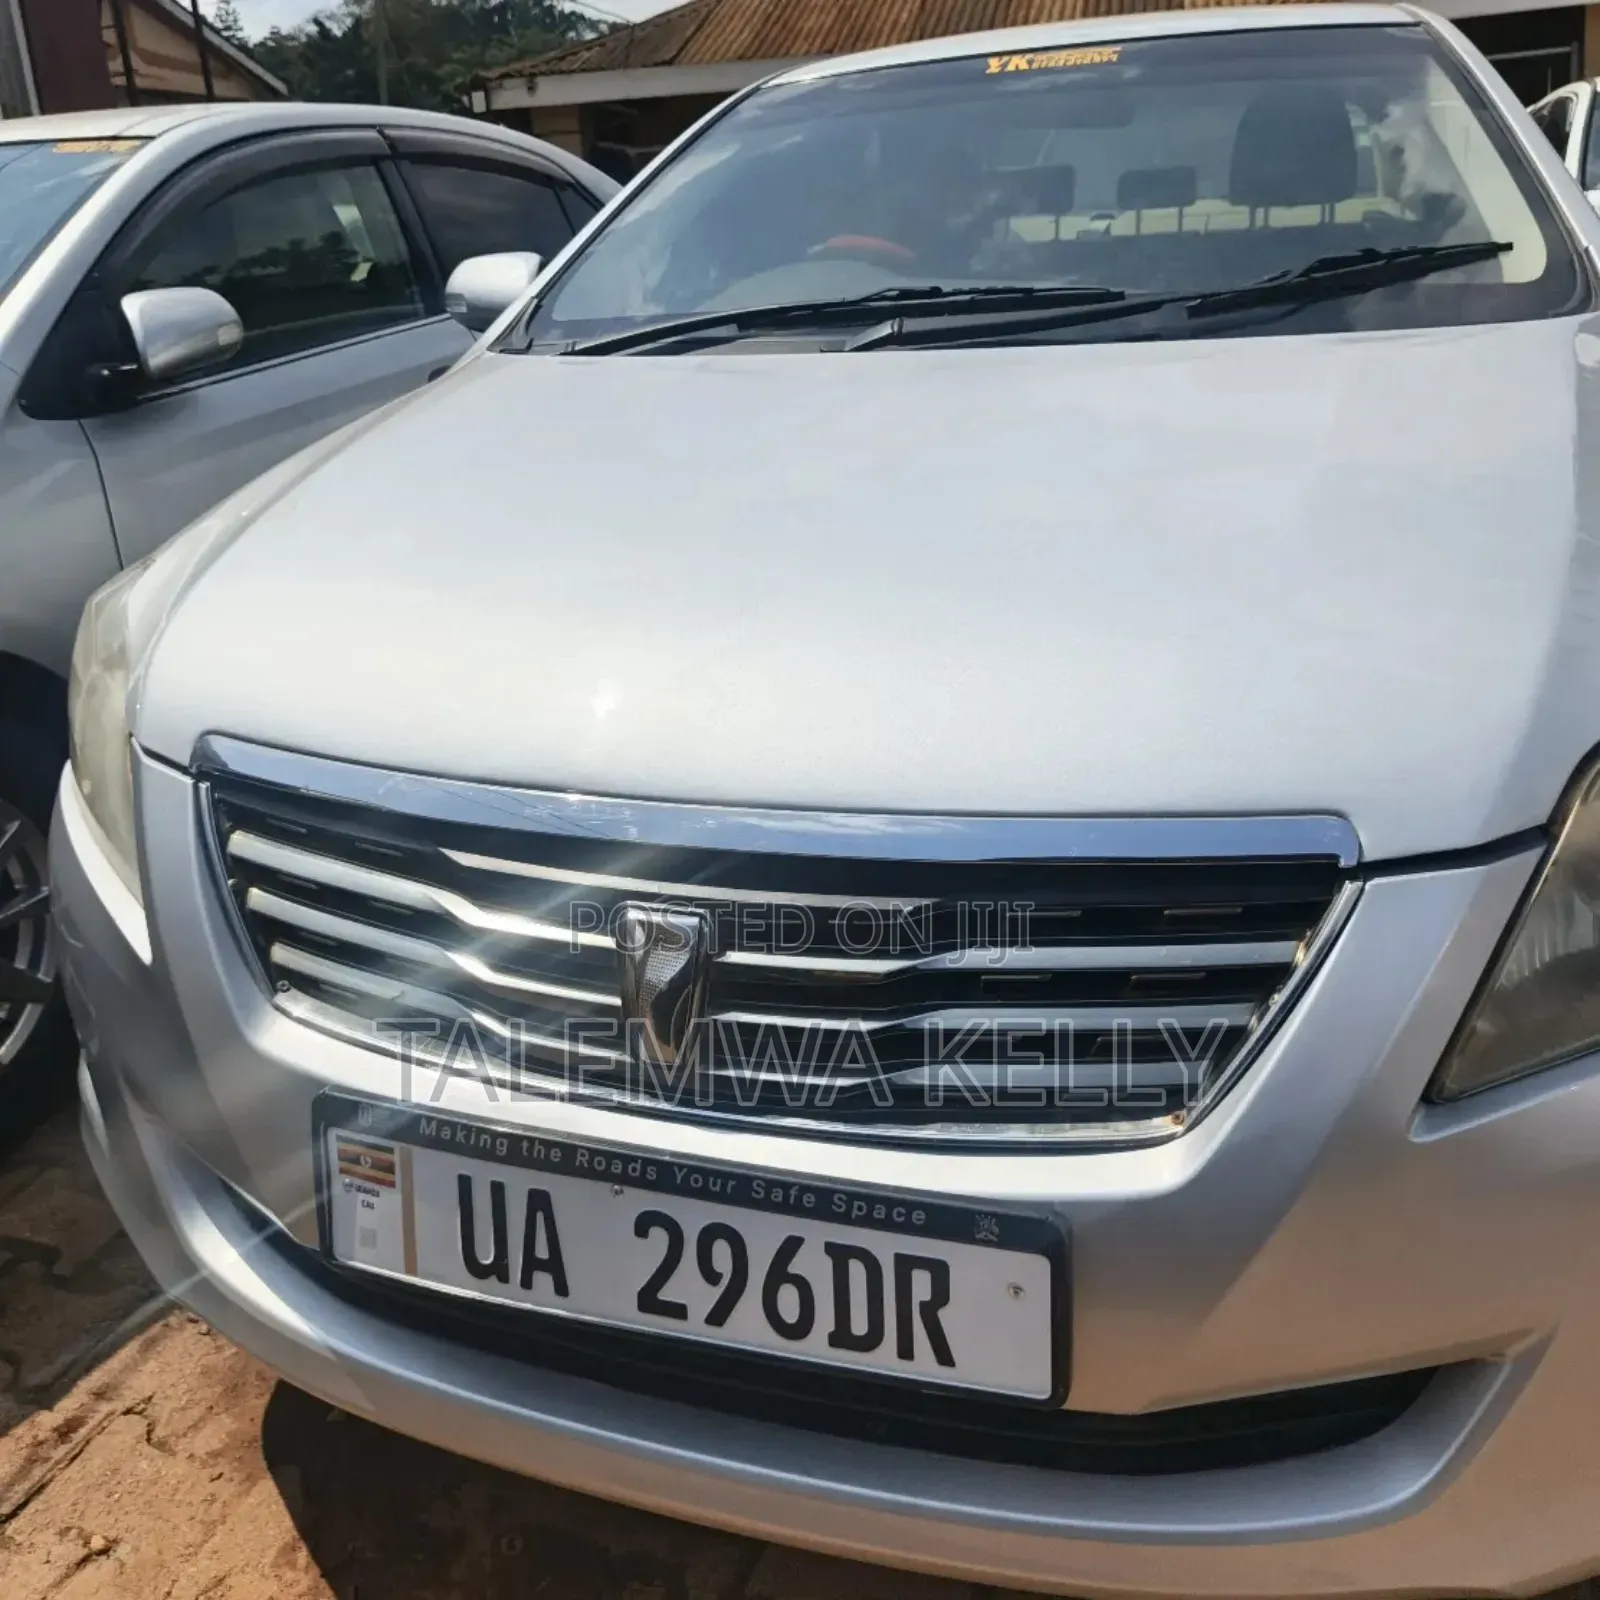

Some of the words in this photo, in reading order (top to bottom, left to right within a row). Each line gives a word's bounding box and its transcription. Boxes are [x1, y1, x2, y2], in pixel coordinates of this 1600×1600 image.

[419, 1117, 508, 1156] Making
[521, 1139, 562, 1163] the
[576, 1149, 657, 1180] Roads
[672, 1165, 737, 1194] Your
[752, 1180, 816, 1209] Safe
[831, 1193, 927, 1225] Space
[457, 1173, 570, 1298] UA
[632, 1209, 957, 1368] 296DR
